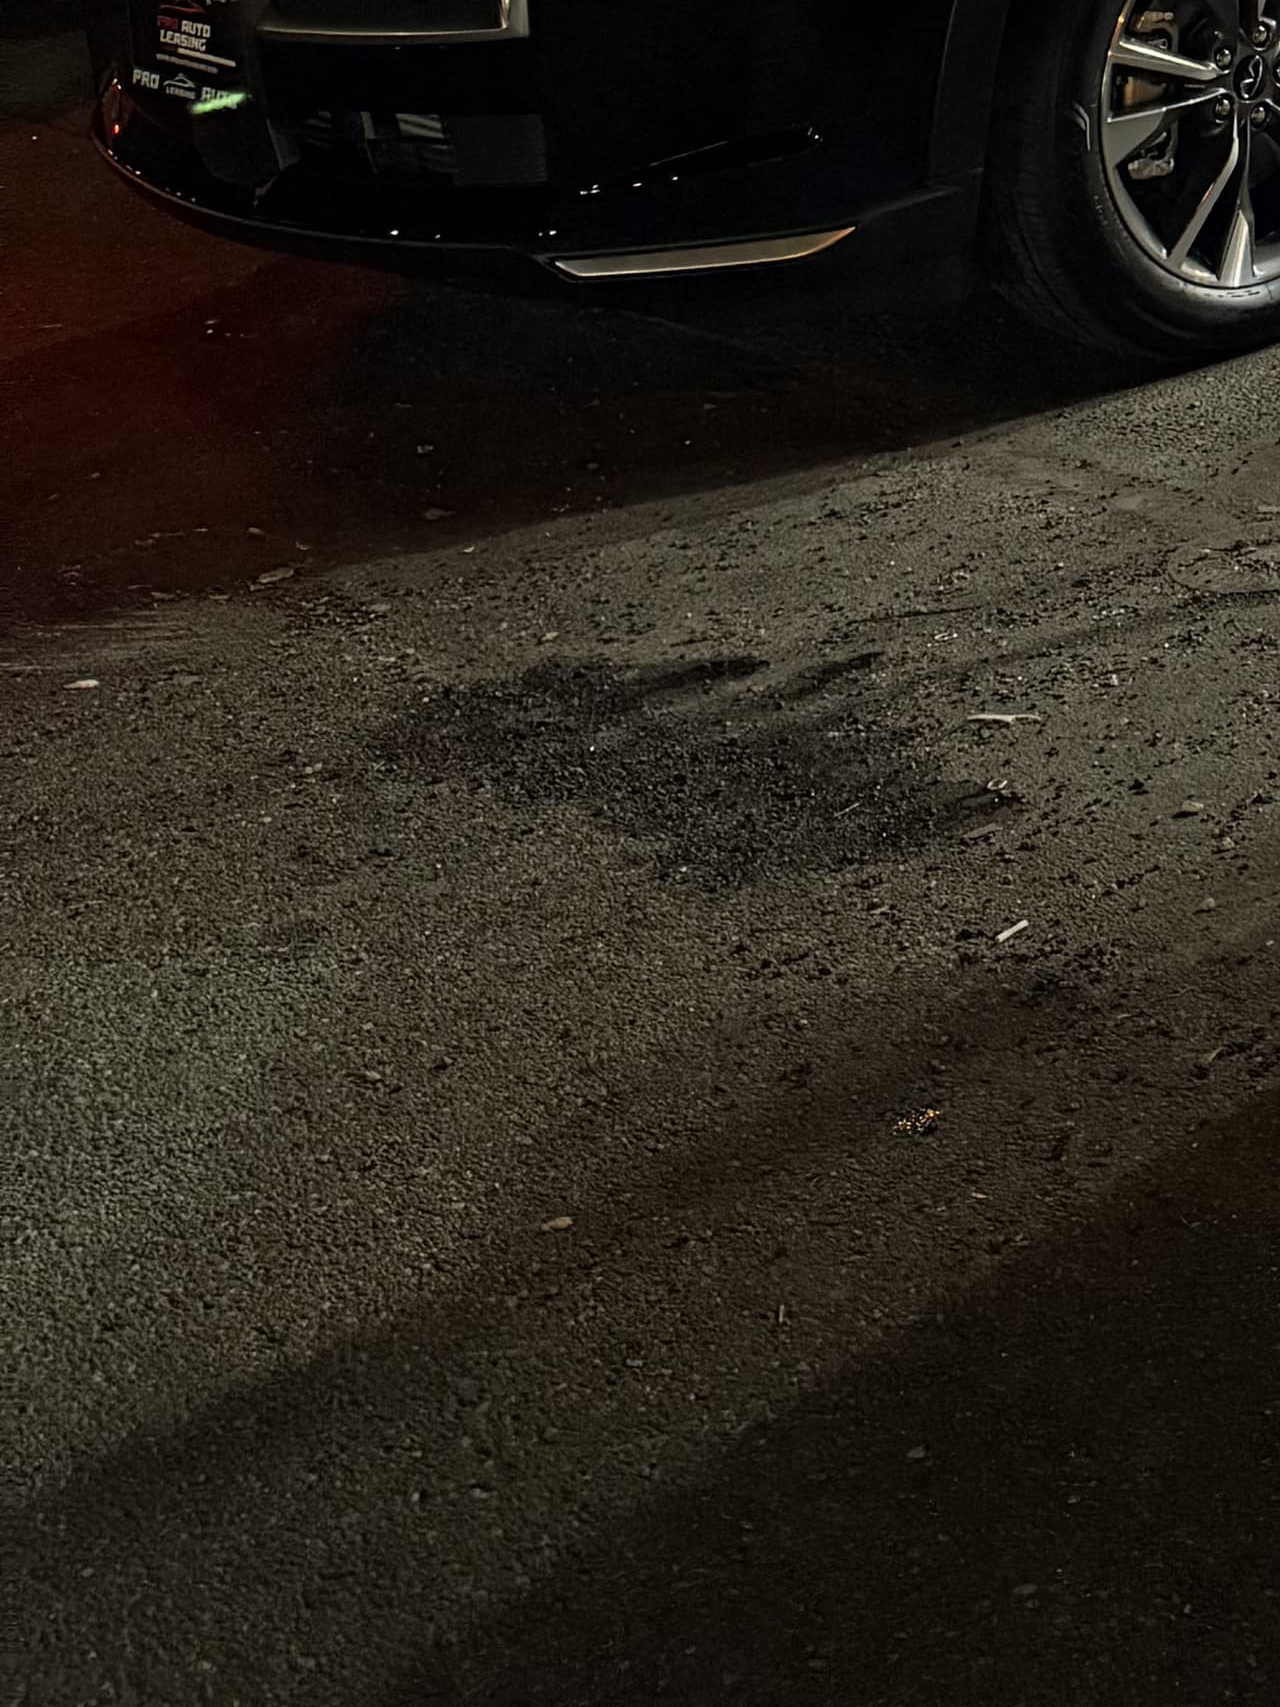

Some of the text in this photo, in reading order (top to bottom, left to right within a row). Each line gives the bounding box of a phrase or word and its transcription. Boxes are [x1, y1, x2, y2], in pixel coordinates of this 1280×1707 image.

[181, 19, 212, 38] AUTO
[159, 29, 207, 52] LEASING
[132, 68, 160, 90] PRO
